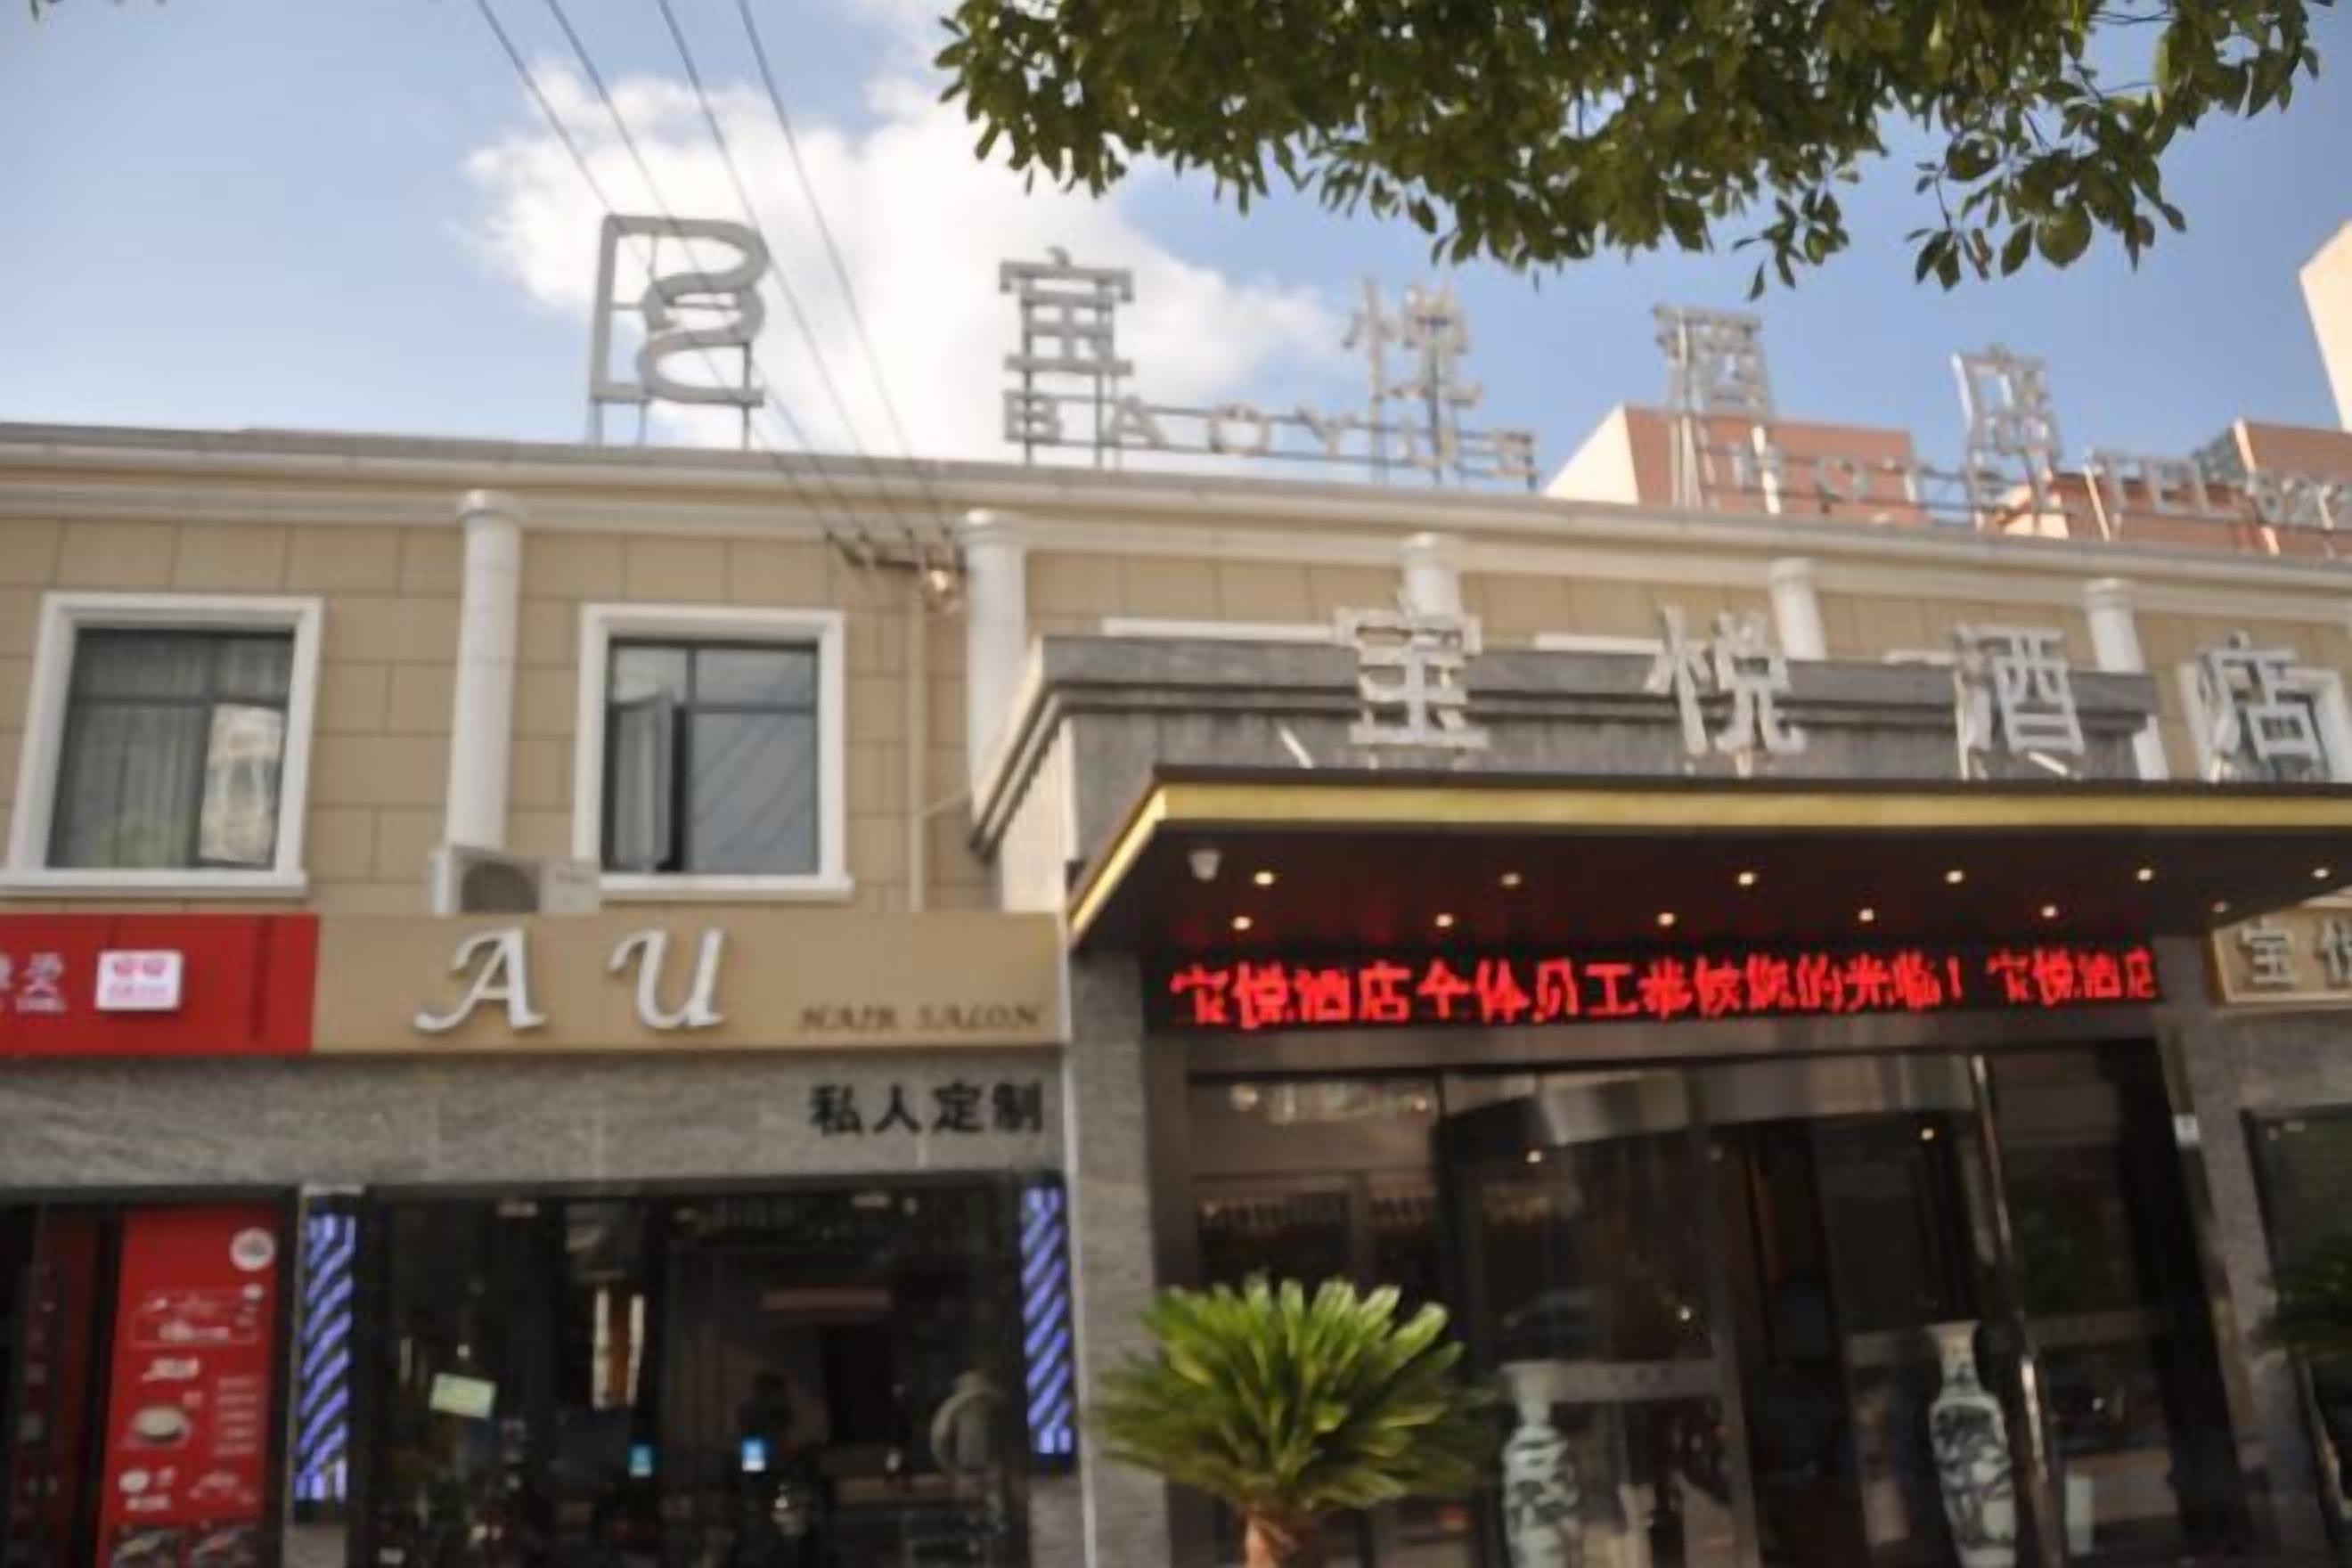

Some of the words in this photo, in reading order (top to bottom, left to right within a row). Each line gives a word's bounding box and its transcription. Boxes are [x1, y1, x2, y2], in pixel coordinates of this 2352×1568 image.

[1334, 604, 2322, 763] 宝悦酒店
[809, 1080, 1044, 1137] 私人定制
